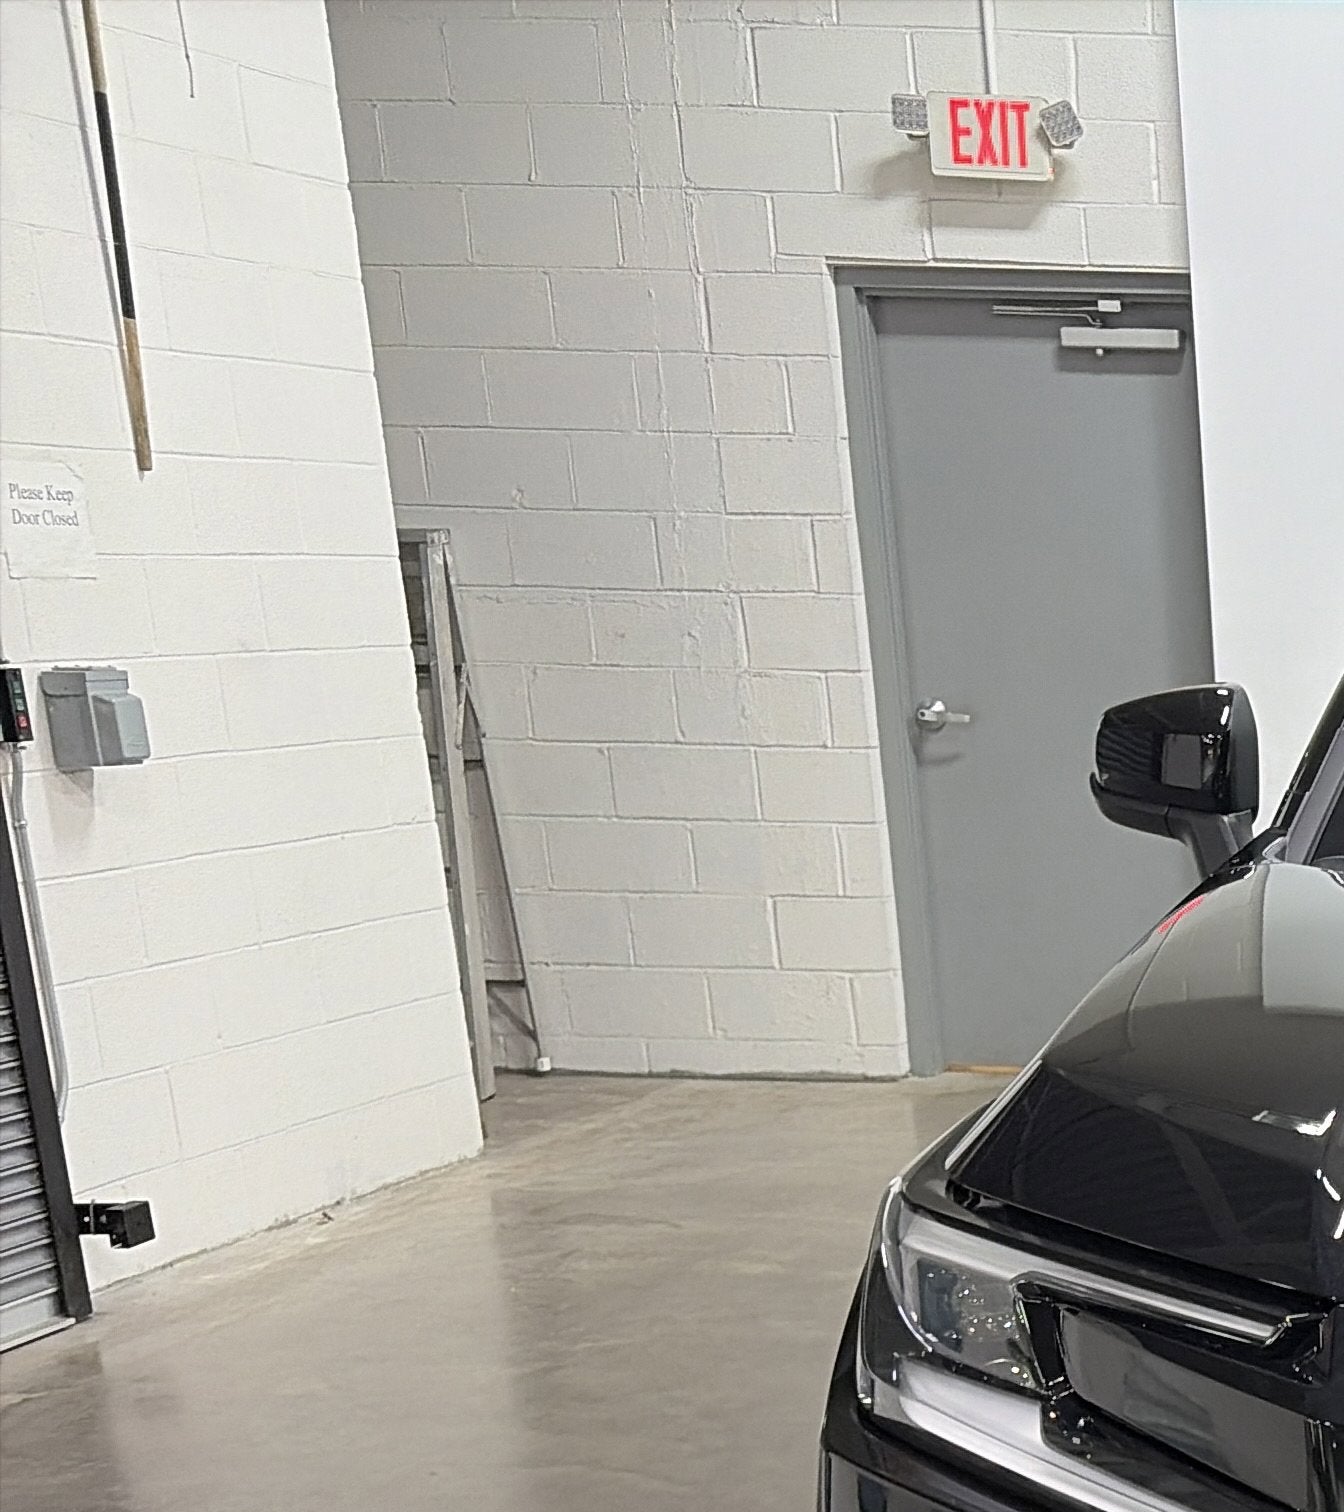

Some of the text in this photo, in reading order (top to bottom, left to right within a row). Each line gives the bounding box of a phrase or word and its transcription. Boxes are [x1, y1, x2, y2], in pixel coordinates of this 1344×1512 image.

[949, 98, 1030, 167] EXIT
[8, 482, 74, 506] Please Keep
[11, 508, 79, 526] Door Closed
